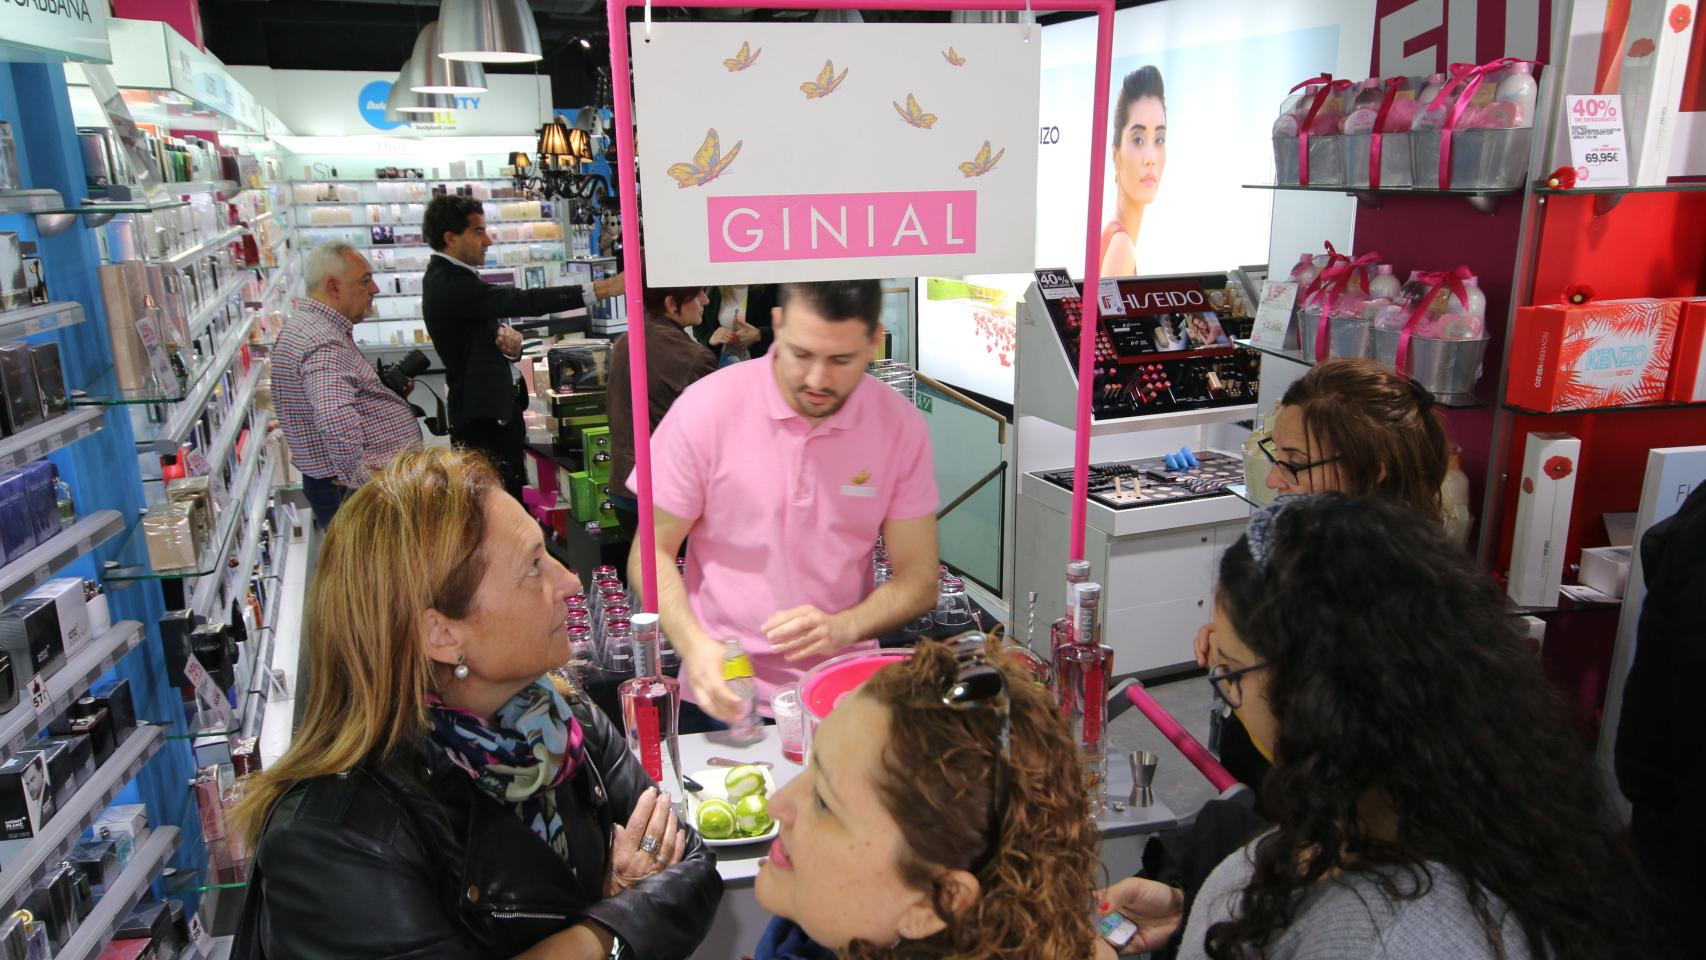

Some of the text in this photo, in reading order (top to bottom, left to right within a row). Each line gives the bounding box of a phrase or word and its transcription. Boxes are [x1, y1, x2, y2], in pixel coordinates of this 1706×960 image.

[1572, 99, 1617, 118] 40%
[722, 202, 964, 253] GINIAL
[1040, 273, 1070, 286] 40%
[1586, 344, 1648, 371] KENZO
